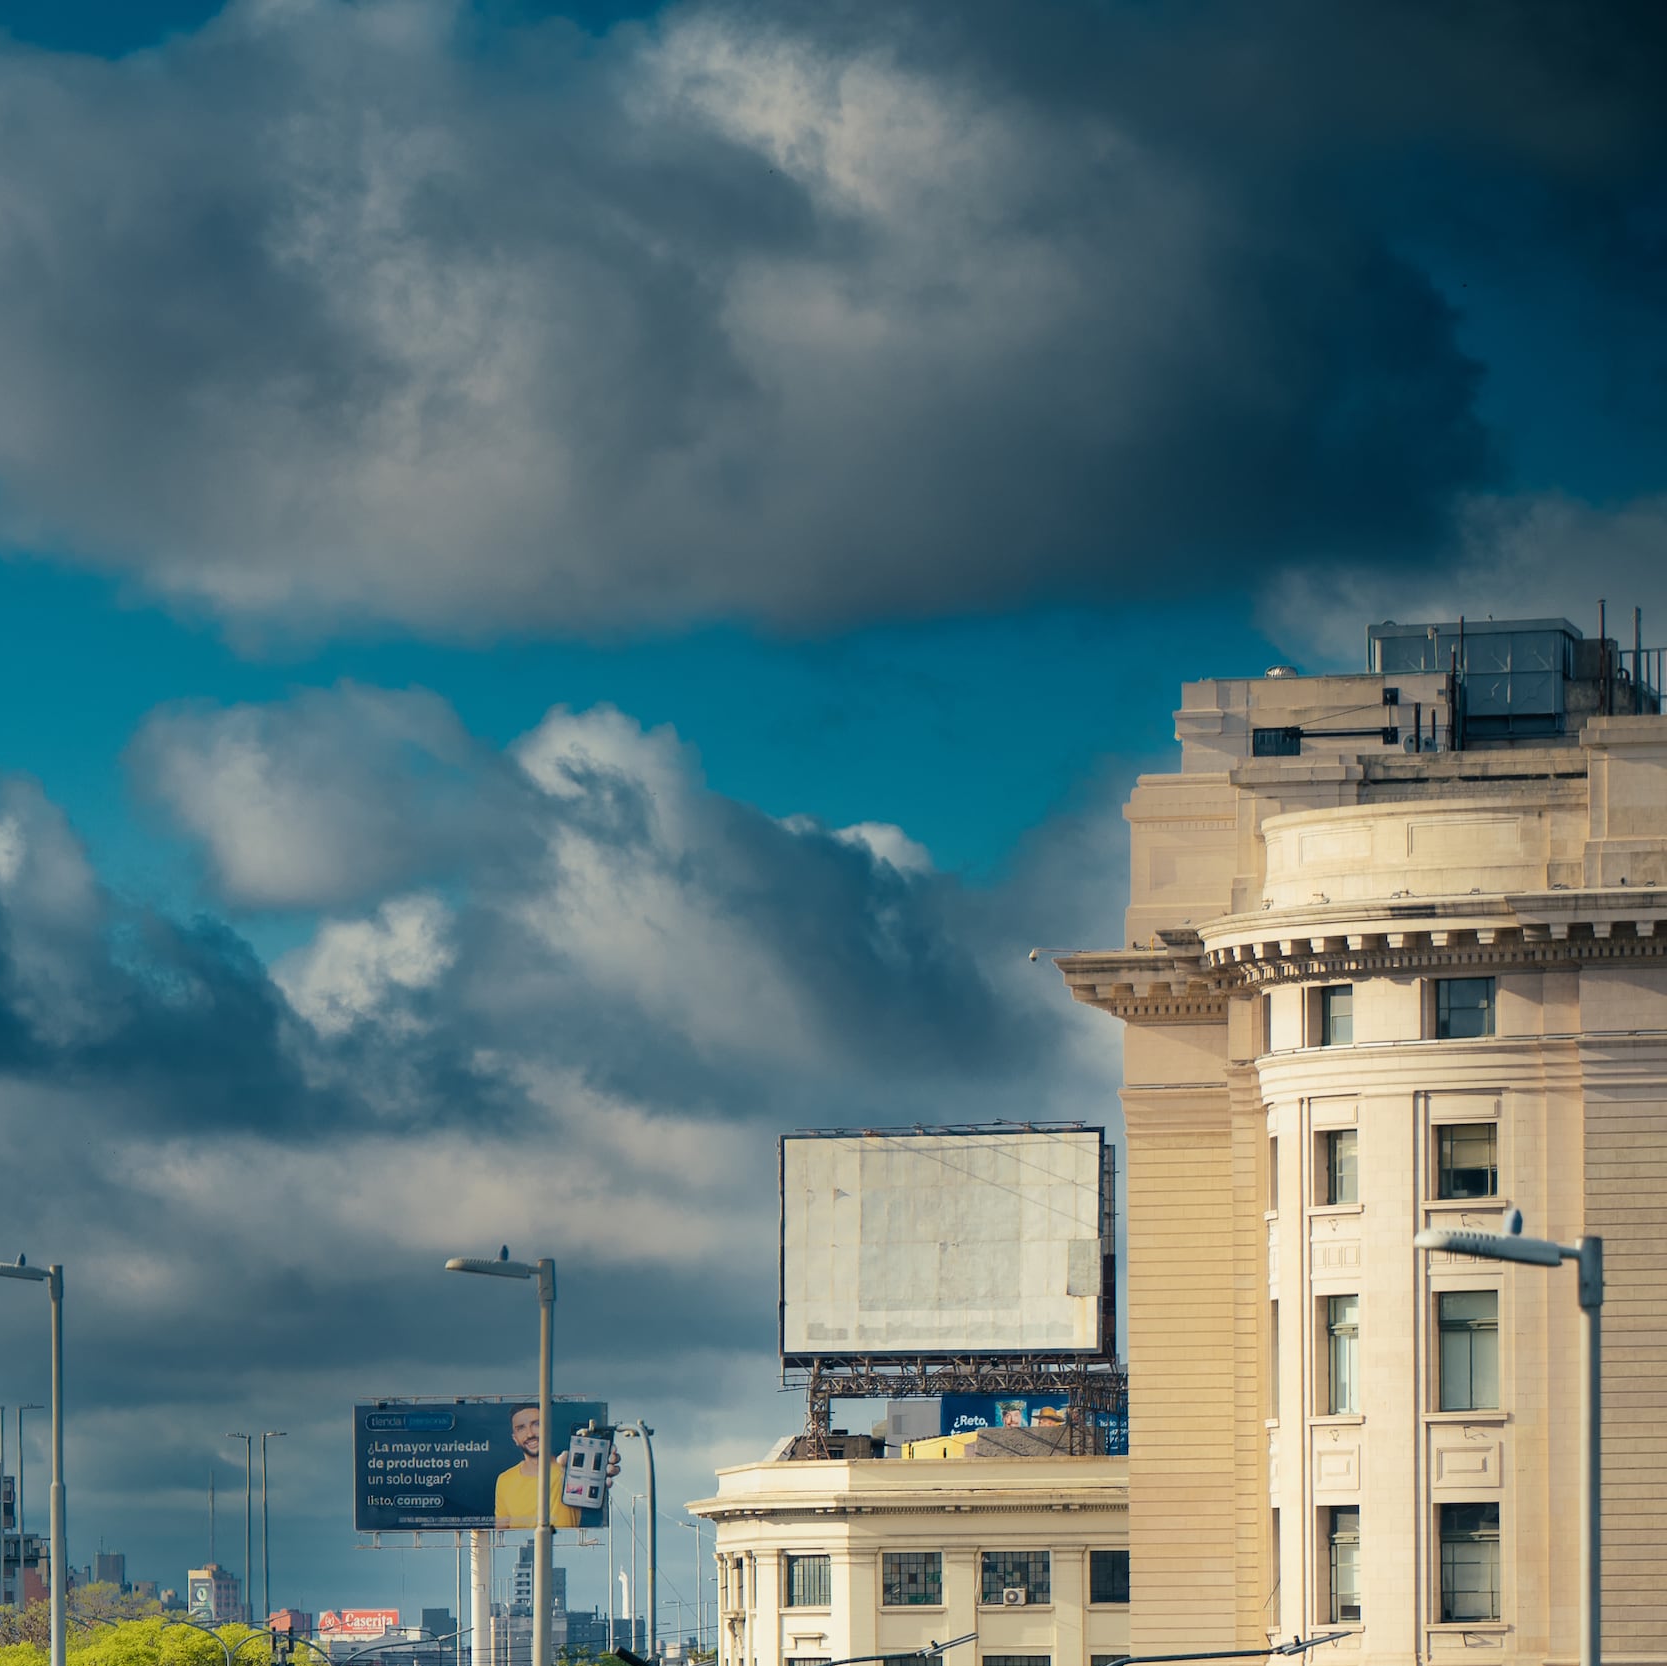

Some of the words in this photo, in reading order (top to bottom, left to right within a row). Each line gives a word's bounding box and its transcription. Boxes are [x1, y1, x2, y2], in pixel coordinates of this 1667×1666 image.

[371, 1416, 402, 1427] tienda
[953, 1415, 988, 1428] ¿Reto,
[367, 1440, 389, 1455] ¿La
[391, 1442, 431, 1455] mayor
[433, 1440, 489, 1452] variedad
[367, 1457, 384, 1469] de
[386, 1457, 451, 1471] productos
[453, 1458, 469, 1468] en
[367, 1475, 383, 1485] un
[386, 1473, 412, 1485] solo
[414, 1472, 452, 1487] lugar?
[367, 1495, 393, 1507] listo,
[396, 1496, 442, 1508] compro
